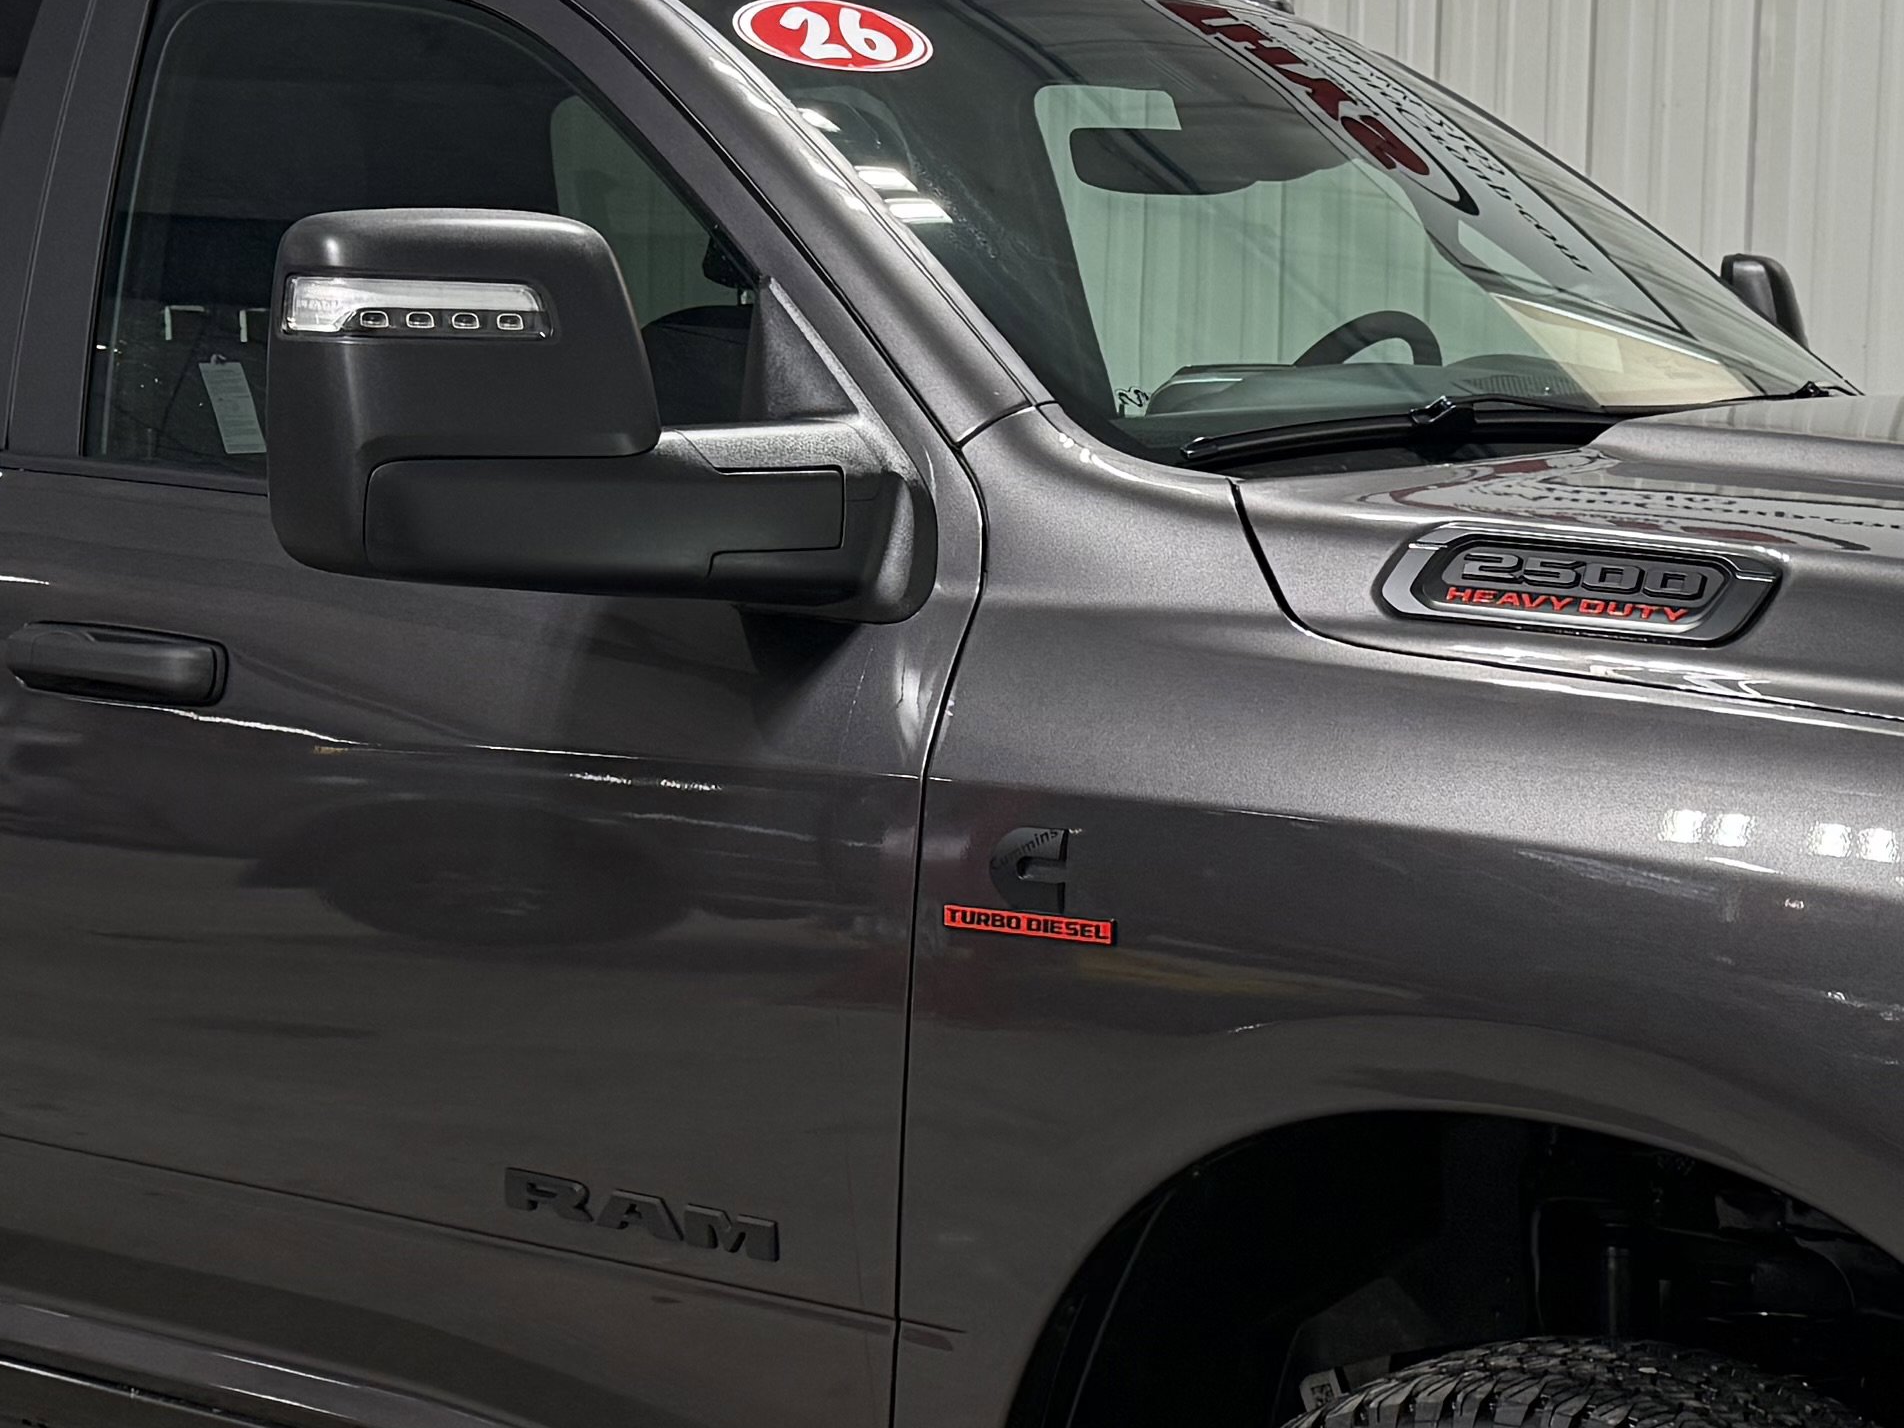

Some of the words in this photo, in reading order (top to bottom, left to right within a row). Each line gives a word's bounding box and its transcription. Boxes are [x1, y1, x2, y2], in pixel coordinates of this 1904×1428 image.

[779, 6, 898, 62] 26
[1461, 552, 1708, 601] 2500
[1446, 587, 1575, 612] HEAVY
[1578, 598, 1690, 622] DUTY
[946, 907, 1022, 930] TURBO
[1026, 916, 1110, 940] DIESEL
[504, 1167, 781, 1262] RAM
